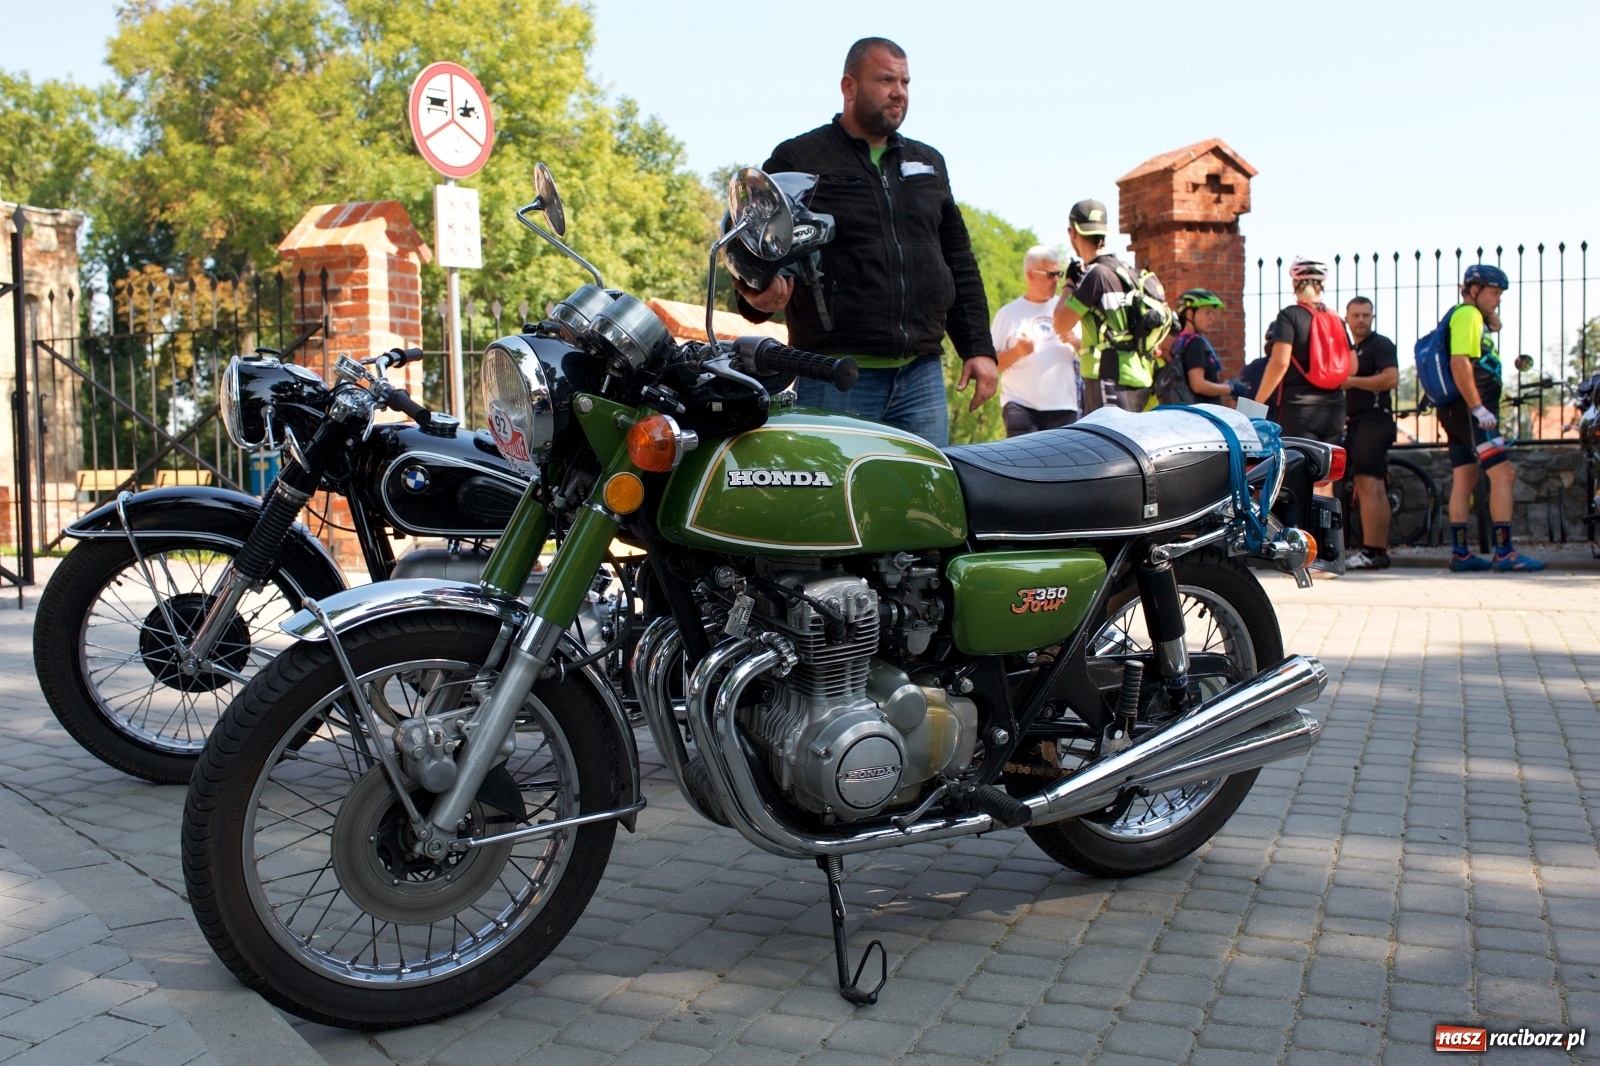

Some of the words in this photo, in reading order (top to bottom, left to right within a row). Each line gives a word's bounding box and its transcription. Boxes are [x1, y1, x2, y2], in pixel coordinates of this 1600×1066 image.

[495, 415, 507, 434] 92
[728, 470, 833, 487] HONDA
[1011, 588, 1066, 614] Four
[1034, 585, 1068, 601] 350
[847, 766, 895, 779] HONDA
